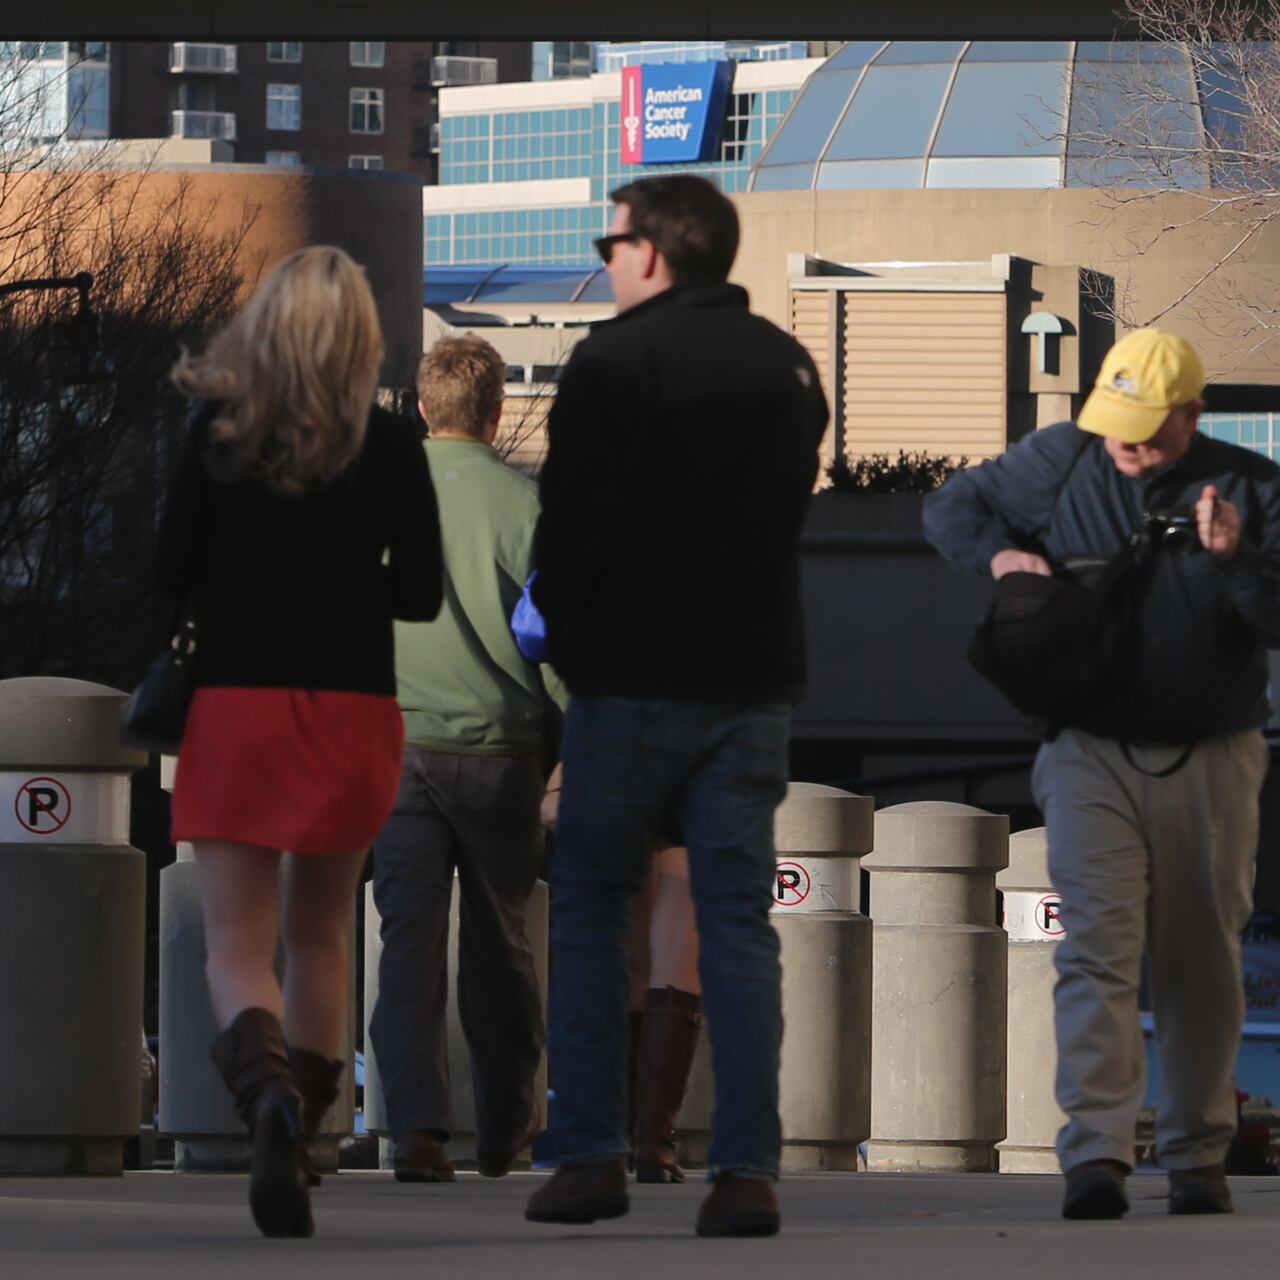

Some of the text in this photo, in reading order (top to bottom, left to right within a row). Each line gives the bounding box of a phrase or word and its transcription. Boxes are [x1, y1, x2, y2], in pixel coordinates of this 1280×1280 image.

[645, 84, 703, 104] American
[645, 104, 687, 121] Cancer
[645, 120, 691, 141] Society
